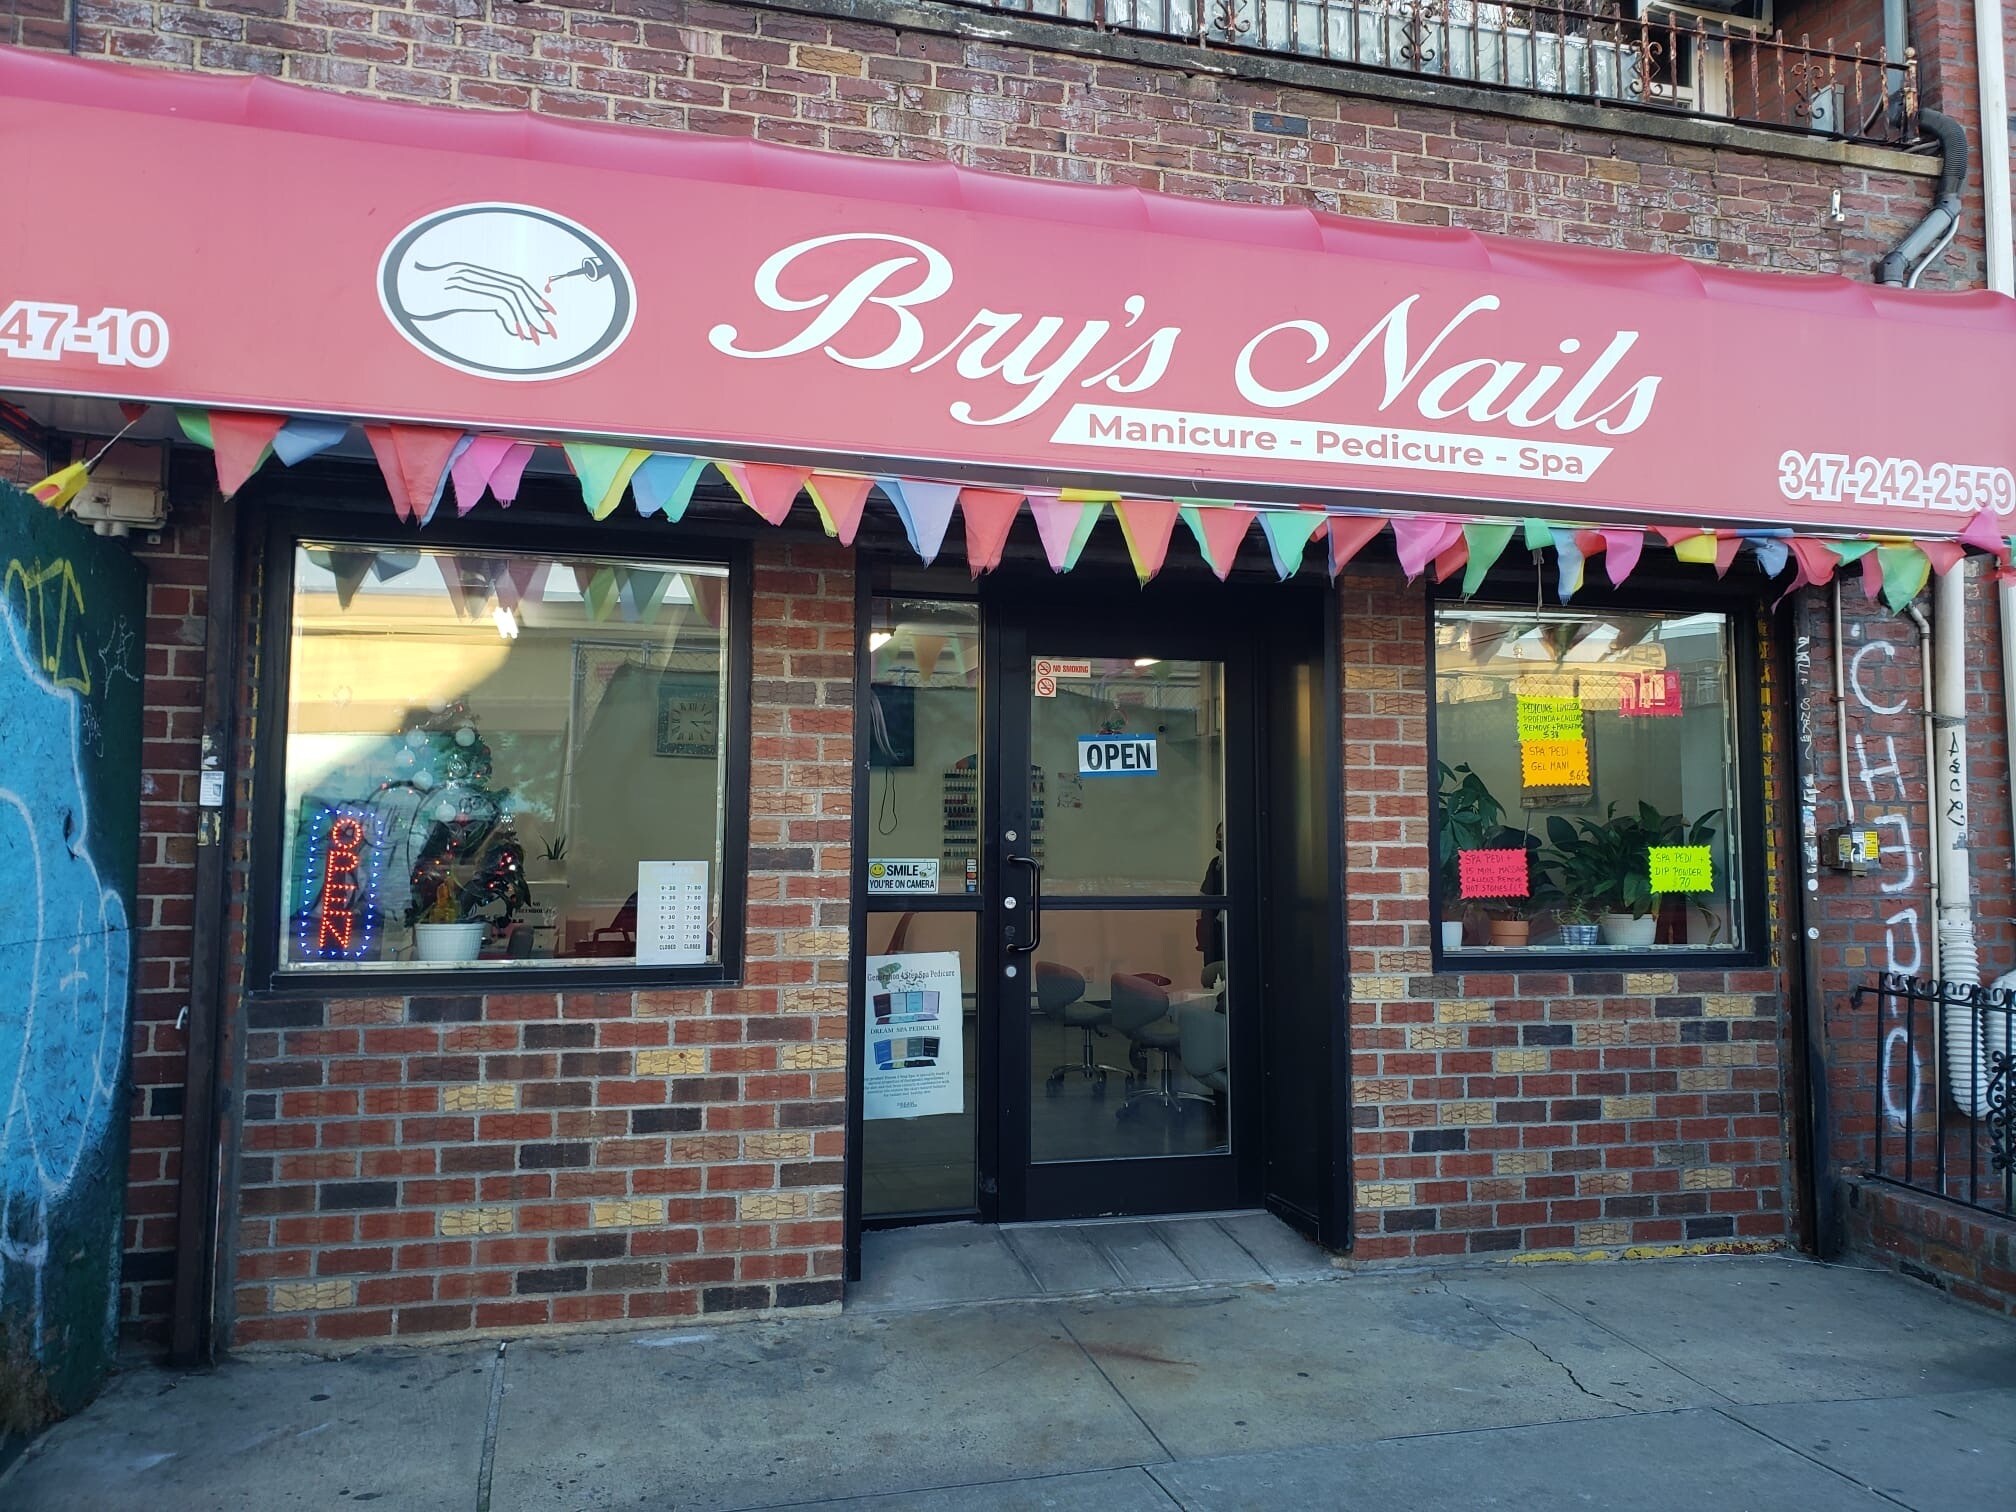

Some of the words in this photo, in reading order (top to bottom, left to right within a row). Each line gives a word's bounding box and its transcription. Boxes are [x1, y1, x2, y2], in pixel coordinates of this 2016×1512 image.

[708, 232, 1182, 426] Bry's
[1235, 294, 1663, 435] Nails
[1089, 413, 1278, 450] Manicure
[1316, 430, 1484, 467] Pedicure
[1518, 447, 1583, 477] Spa
[1779, 450, 2016, 515] 347-242-2559
[1052, 664, 1061, 673] NO
[1062, 664, 1089, 674] SMOKING
[1086, 742, 1152, 770] OPEN
[1528, 746, 1545, 757] SPA
[1549, 745, 1569, 757] PEDI
[1531, 761, 1546, 771] GEL
[886, 864, 919, 877] SMILE
[318, 817, 363, 949] OPEN
[869, 879, 893, 889] YOU'RE
[895, 879, 905, 889] ON
[906, 879, 935, 889] CAMERA
[930, 969, 955, 978] Pedicure
